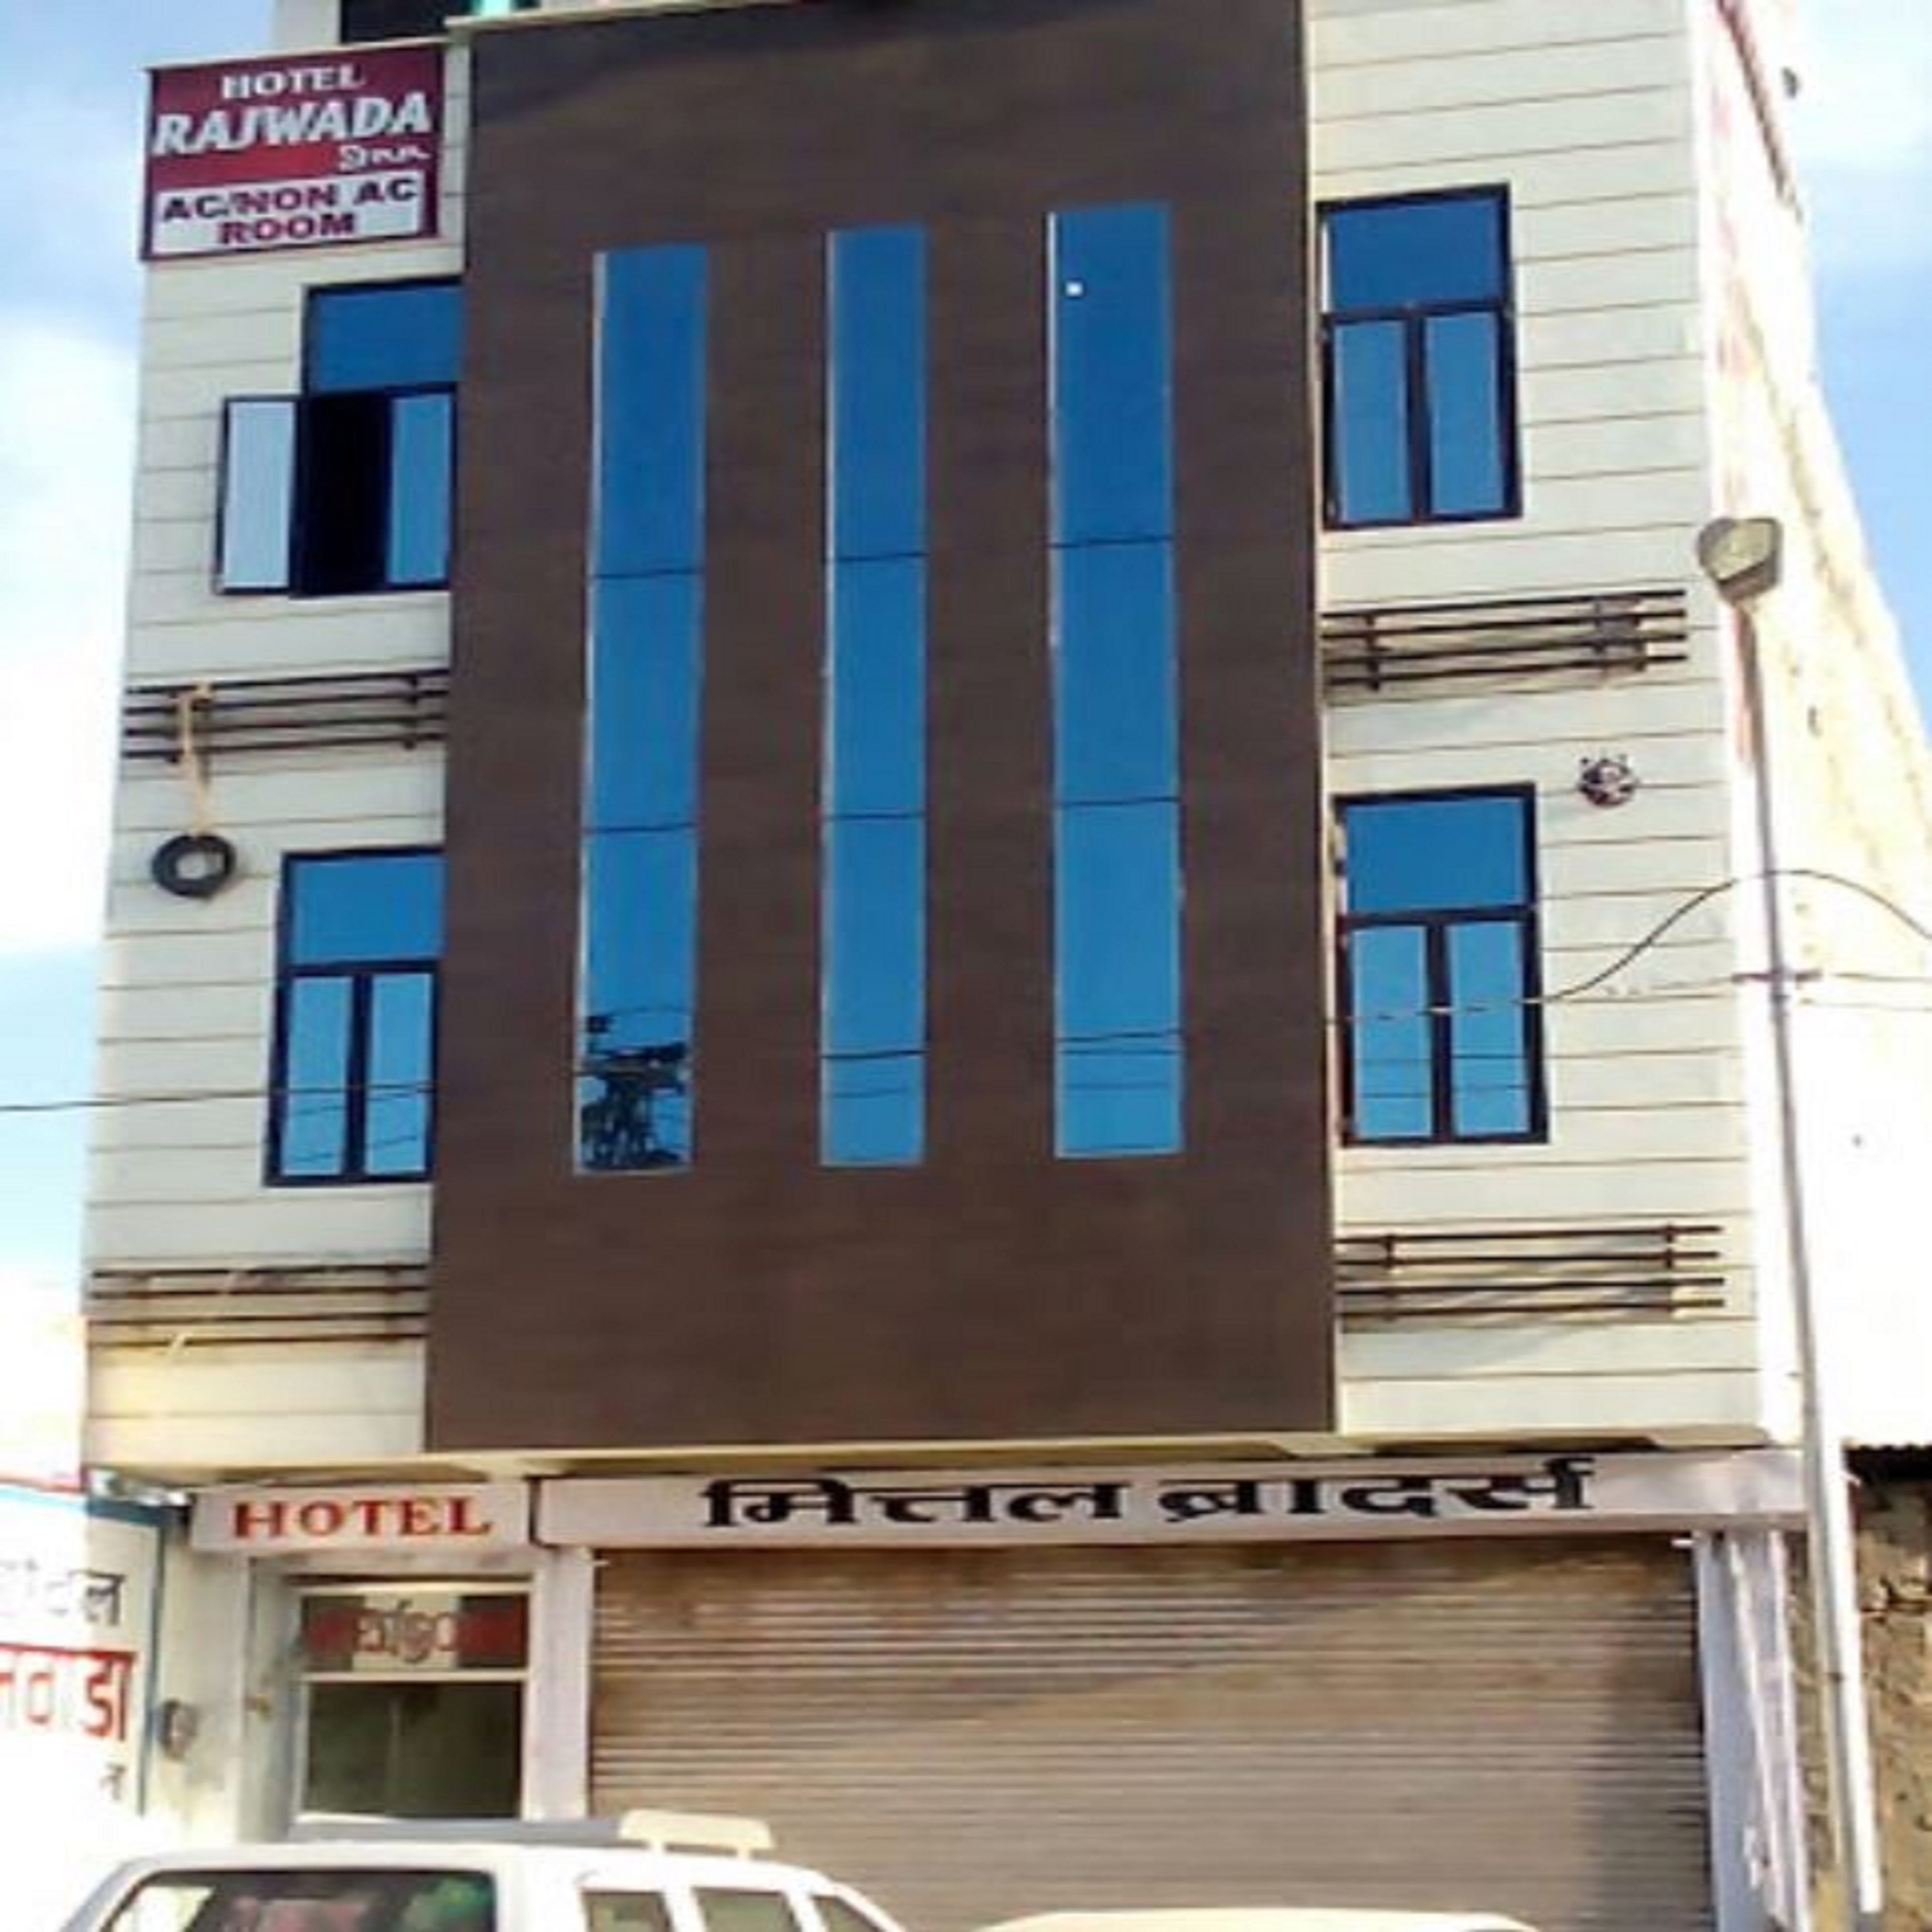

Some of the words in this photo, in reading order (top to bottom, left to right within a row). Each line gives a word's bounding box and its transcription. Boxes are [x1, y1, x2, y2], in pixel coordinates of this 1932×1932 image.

[221, 64, 365, 99] HOTEL
[150, 92, 432, 156] RAJWADA
[353, 178, 418, 205] AC
[218, 213, 356, 243] ROOM
[233, 1496, 492, 1539] HOTEL
